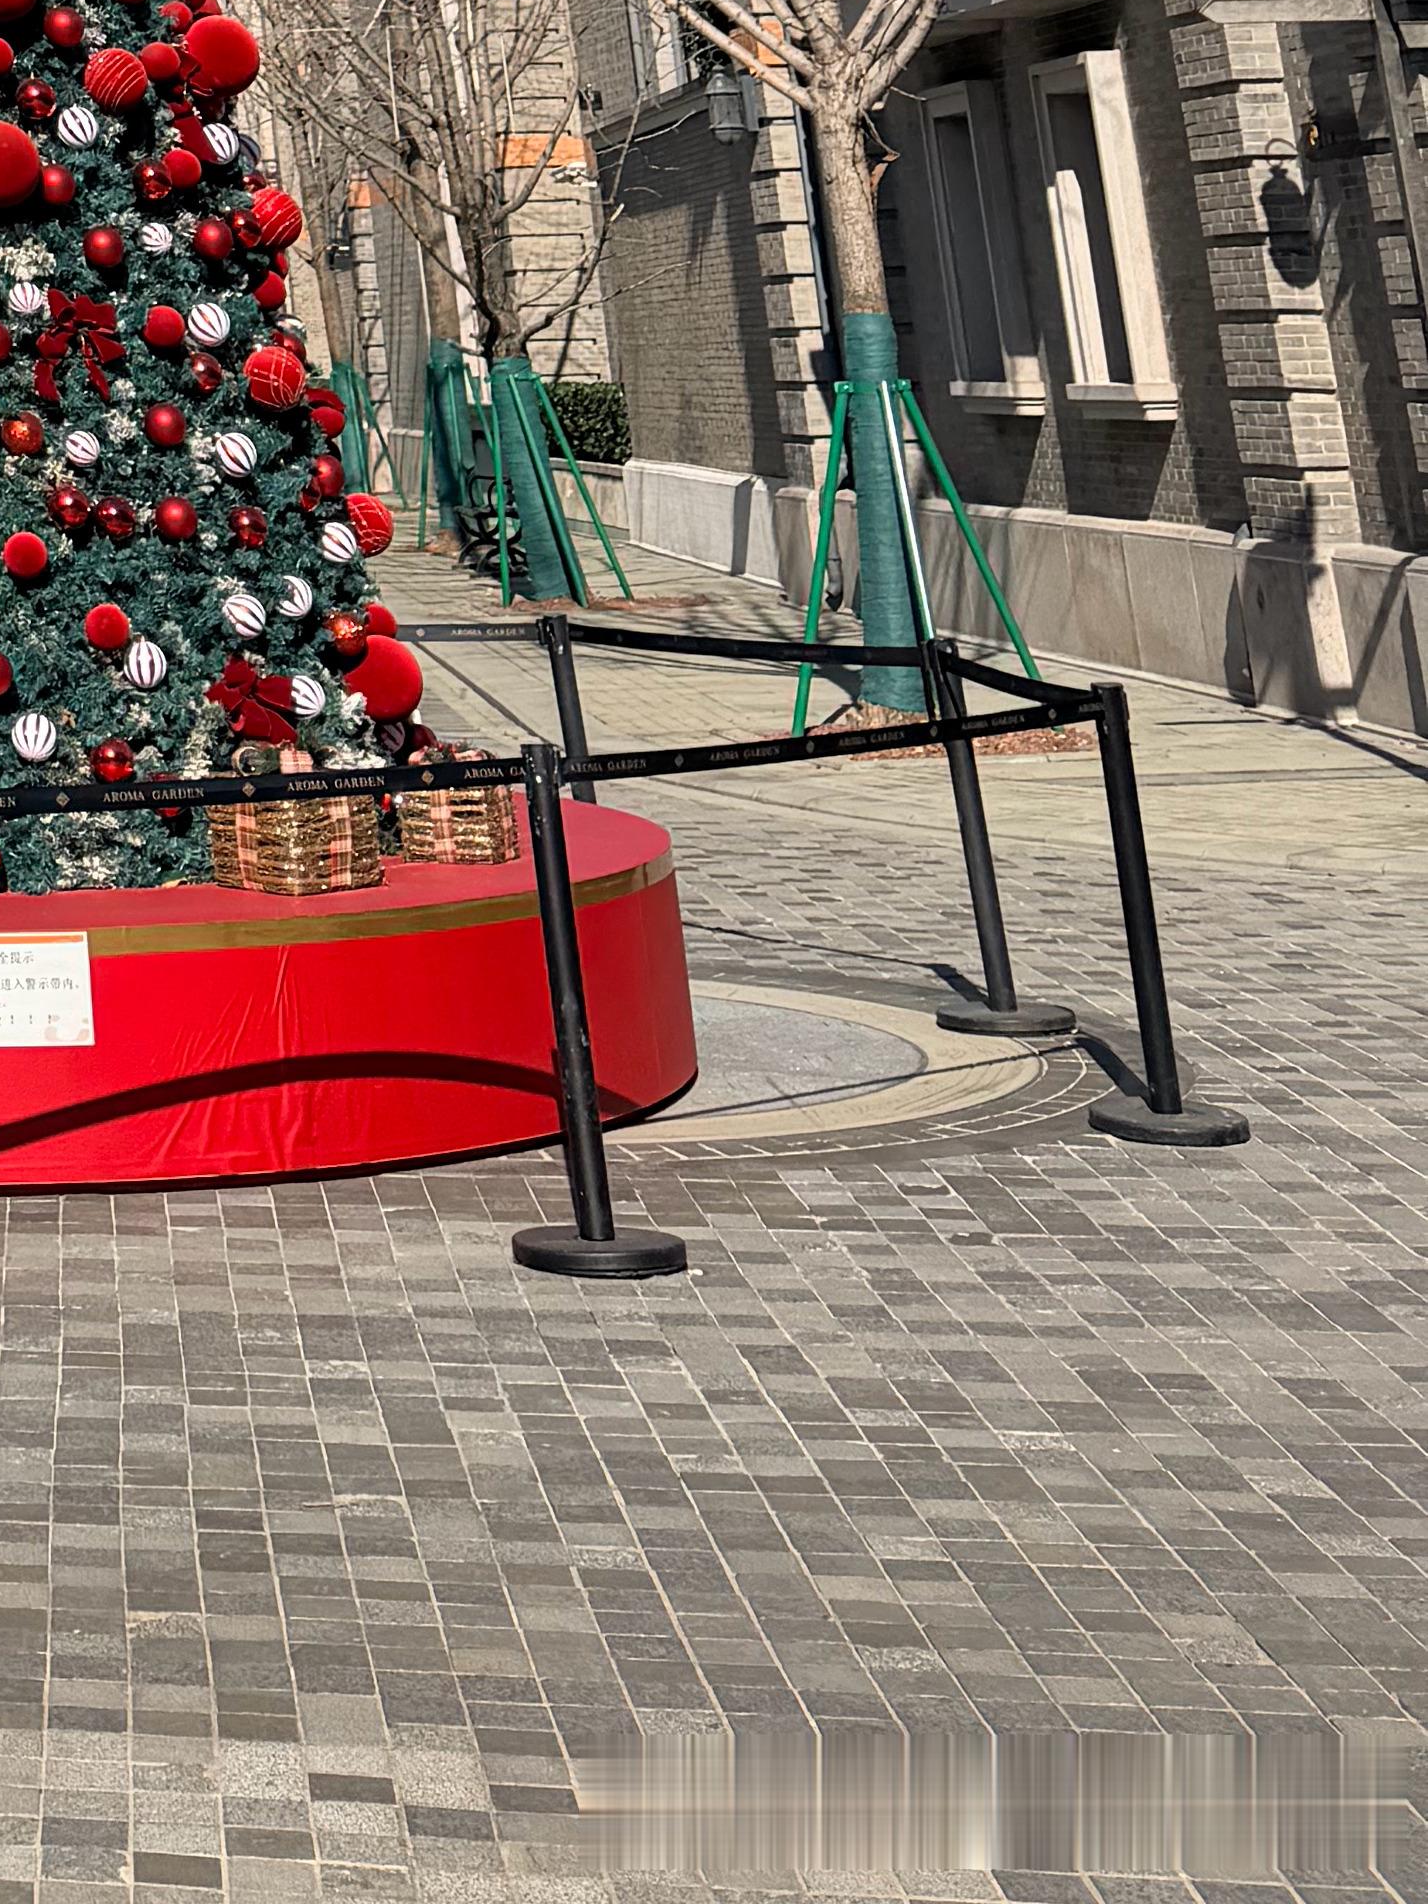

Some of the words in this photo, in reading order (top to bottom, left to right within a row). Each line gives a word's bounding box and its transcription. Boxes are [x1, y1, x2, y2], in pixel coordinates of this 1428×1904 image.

[464, 767, 504, 780] AROMA
[287, 778, 328, 792] AROMA
[334, 775, 386, 789] GARDEN
[103, 790, 145, 803] AROMA
[152, 787, 204, 801] GARDEN
